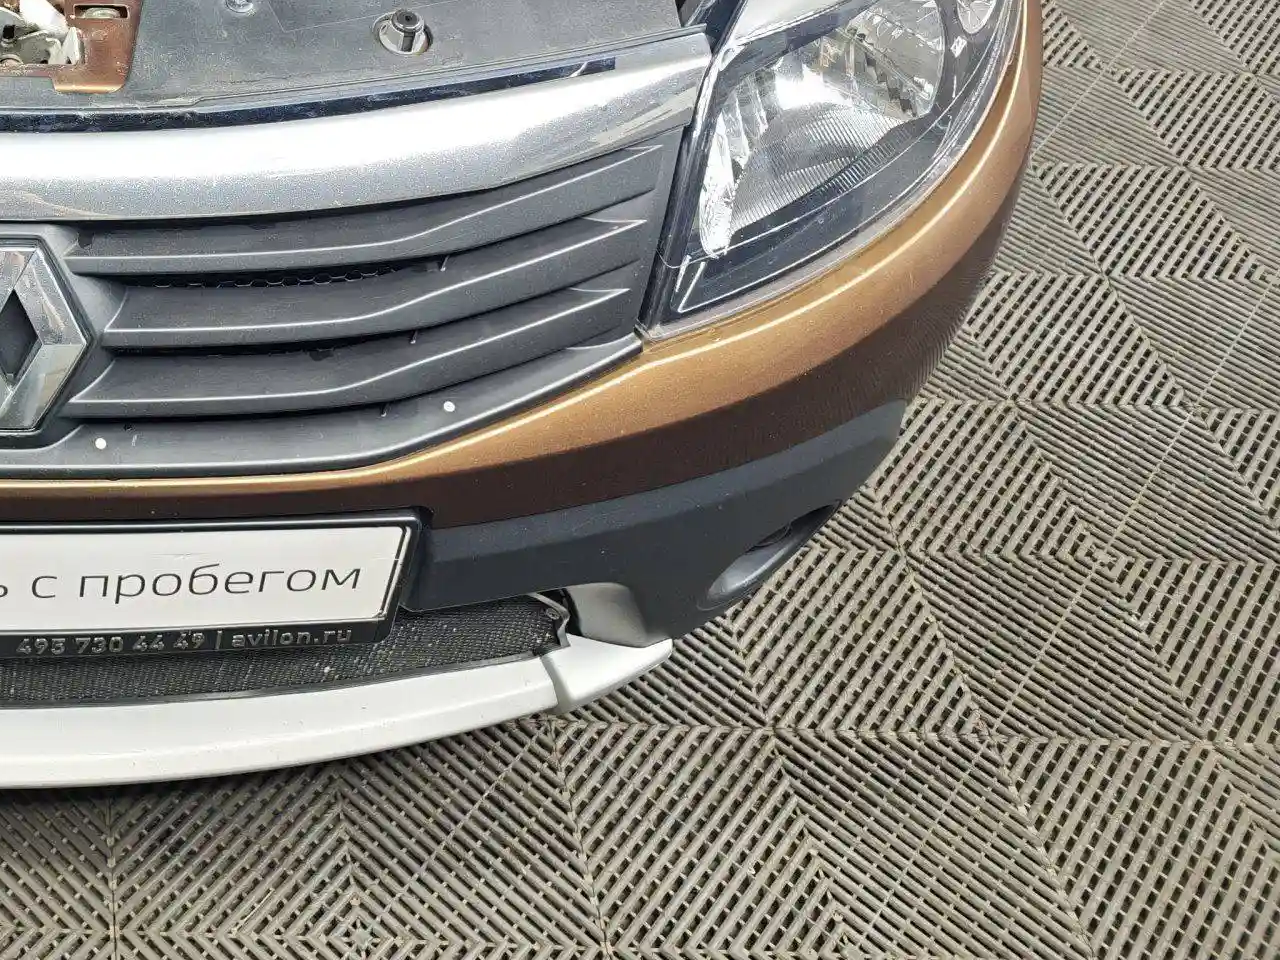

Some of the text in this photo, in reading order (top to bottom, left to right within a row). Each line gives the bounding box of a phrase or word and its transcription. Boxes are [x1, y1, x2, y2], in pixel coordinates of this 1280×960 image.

[31, 574, 58, 599] с
[78, 563, 362, 605] пробегом
[16, 637, 66, 655] 495
[75, 636, 124, 654] 730
[230, 628, 352, 648] avilon.ru
